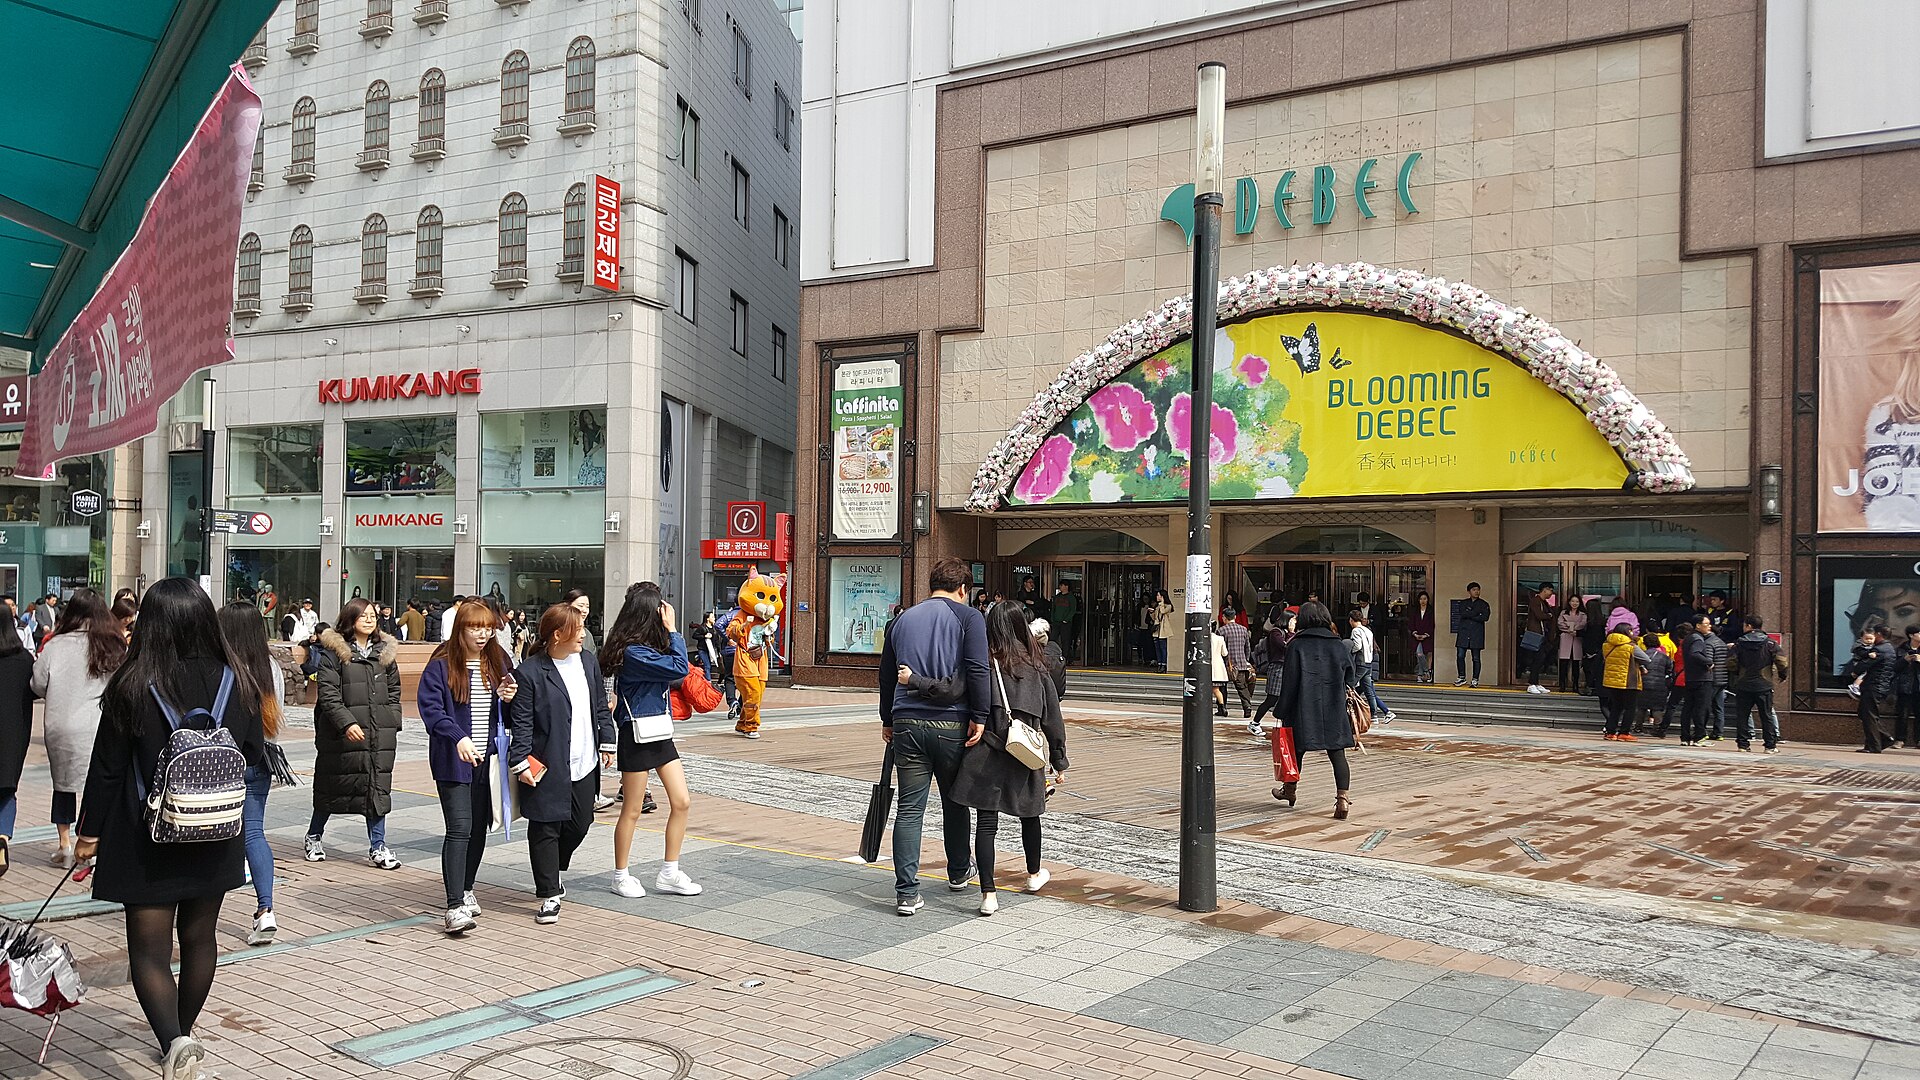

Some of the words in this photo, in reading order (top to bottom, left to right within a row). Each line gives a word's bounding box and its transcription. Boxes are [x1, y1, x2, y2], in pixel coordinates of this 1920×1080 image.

[1235, 151, 1422, 235] DEBEC
[596, 184, 618, 283] 금강제화
[318, 368, 481, 404] KUMKANG
[1328, 367, 1490, 408] BLOOMING
[3, 383, 22, 416] 유
[856, 414, 876, 422] Spaghetti
[1356, 405, 1457, 441] DEBEC
[1401, 454, 1457, 468] 떠다니다!
[1509, 448, 1557, 464] DEBEC
[355, 513, 443, 527] KUMKANG
[749, 541, 769, 550] 안내소
[849, 565, 883, 574] CLINIQUE
